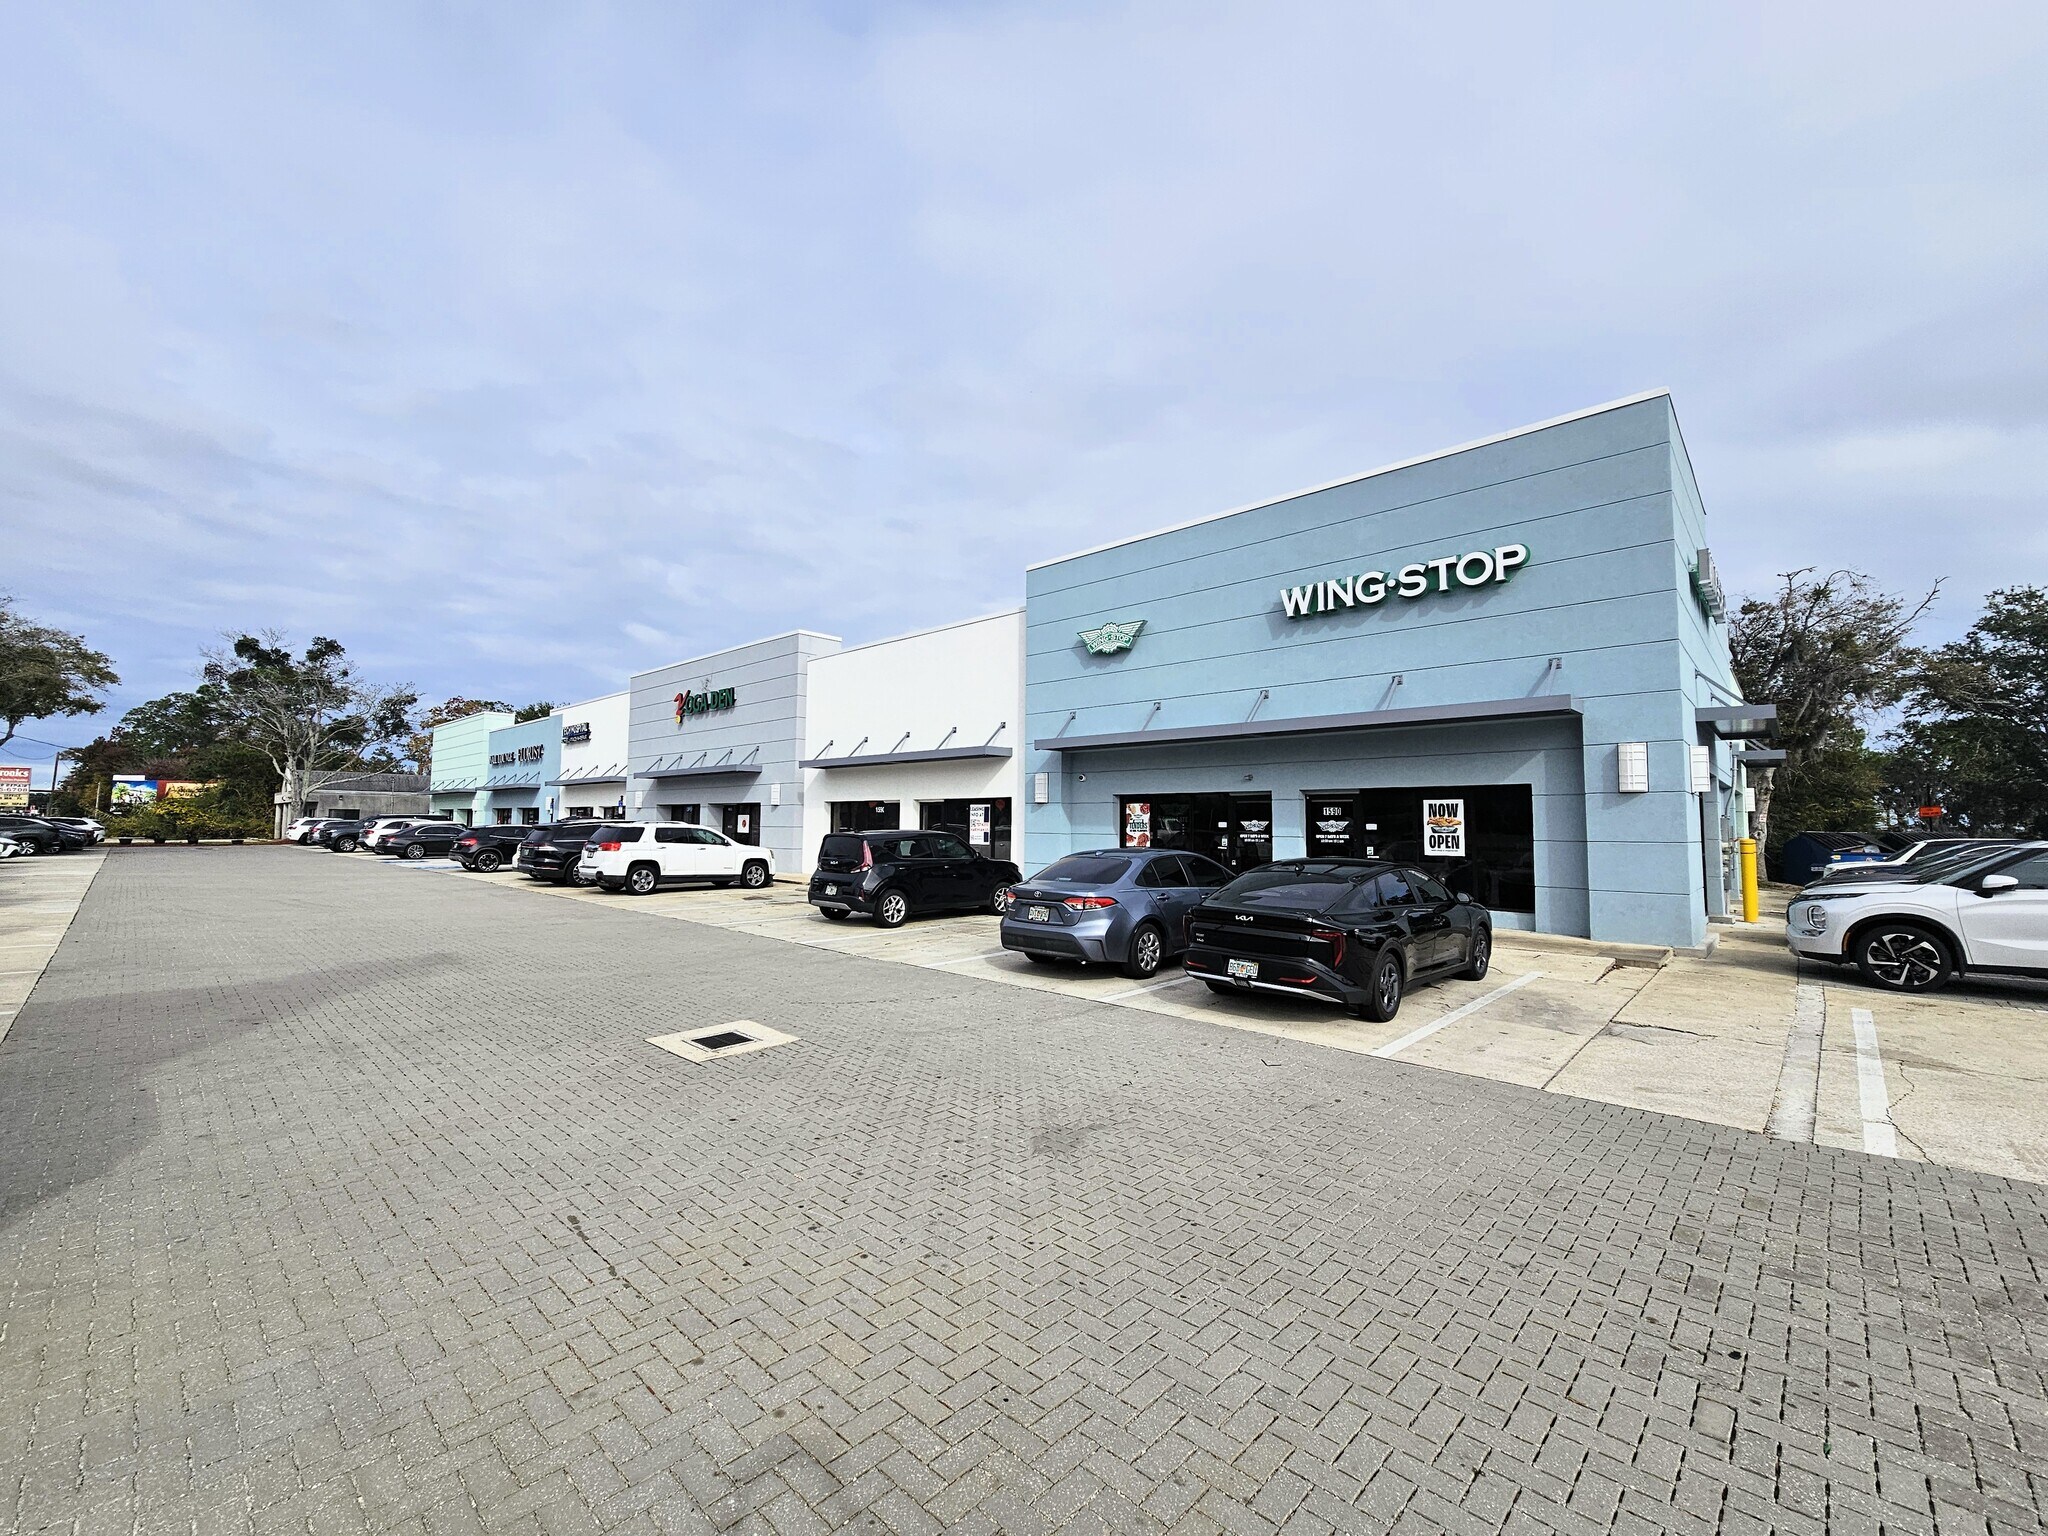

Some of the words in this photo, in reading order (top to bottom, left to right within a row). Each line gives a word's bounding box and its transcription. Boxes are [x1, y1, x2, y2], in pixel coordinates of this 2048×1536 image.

[674, 690, 709, 716] YOGA
[710, 687, 736, 709] DEN
[1323, 807, 1342, 816] 1590
[1428, 803, 1459, 818] NOW
[1428, 834, 1460, 850] OPEN
